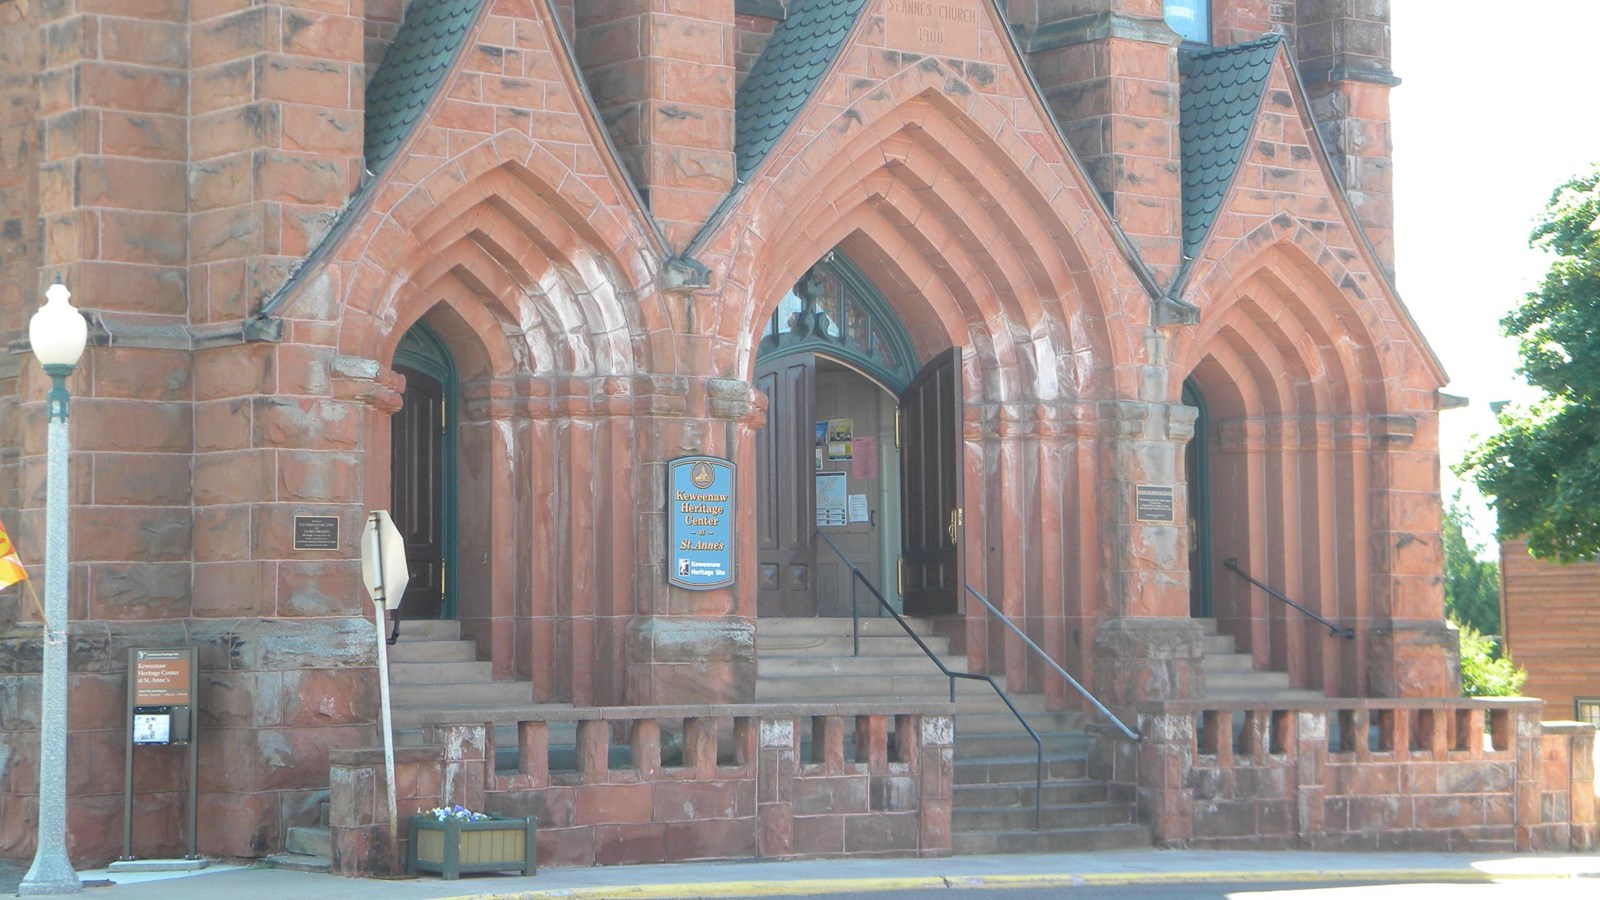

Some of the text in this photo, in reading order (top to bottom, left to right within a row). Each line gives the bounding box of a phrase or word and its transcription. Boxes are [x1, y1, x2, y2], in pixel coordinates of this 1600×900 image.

[938, 5, 976, 24] CHURCH
[676, 490, 729, 502] Keweenaw
[681, 502, 724, 516] Heritage
[685, 515, 720, 526] Center
